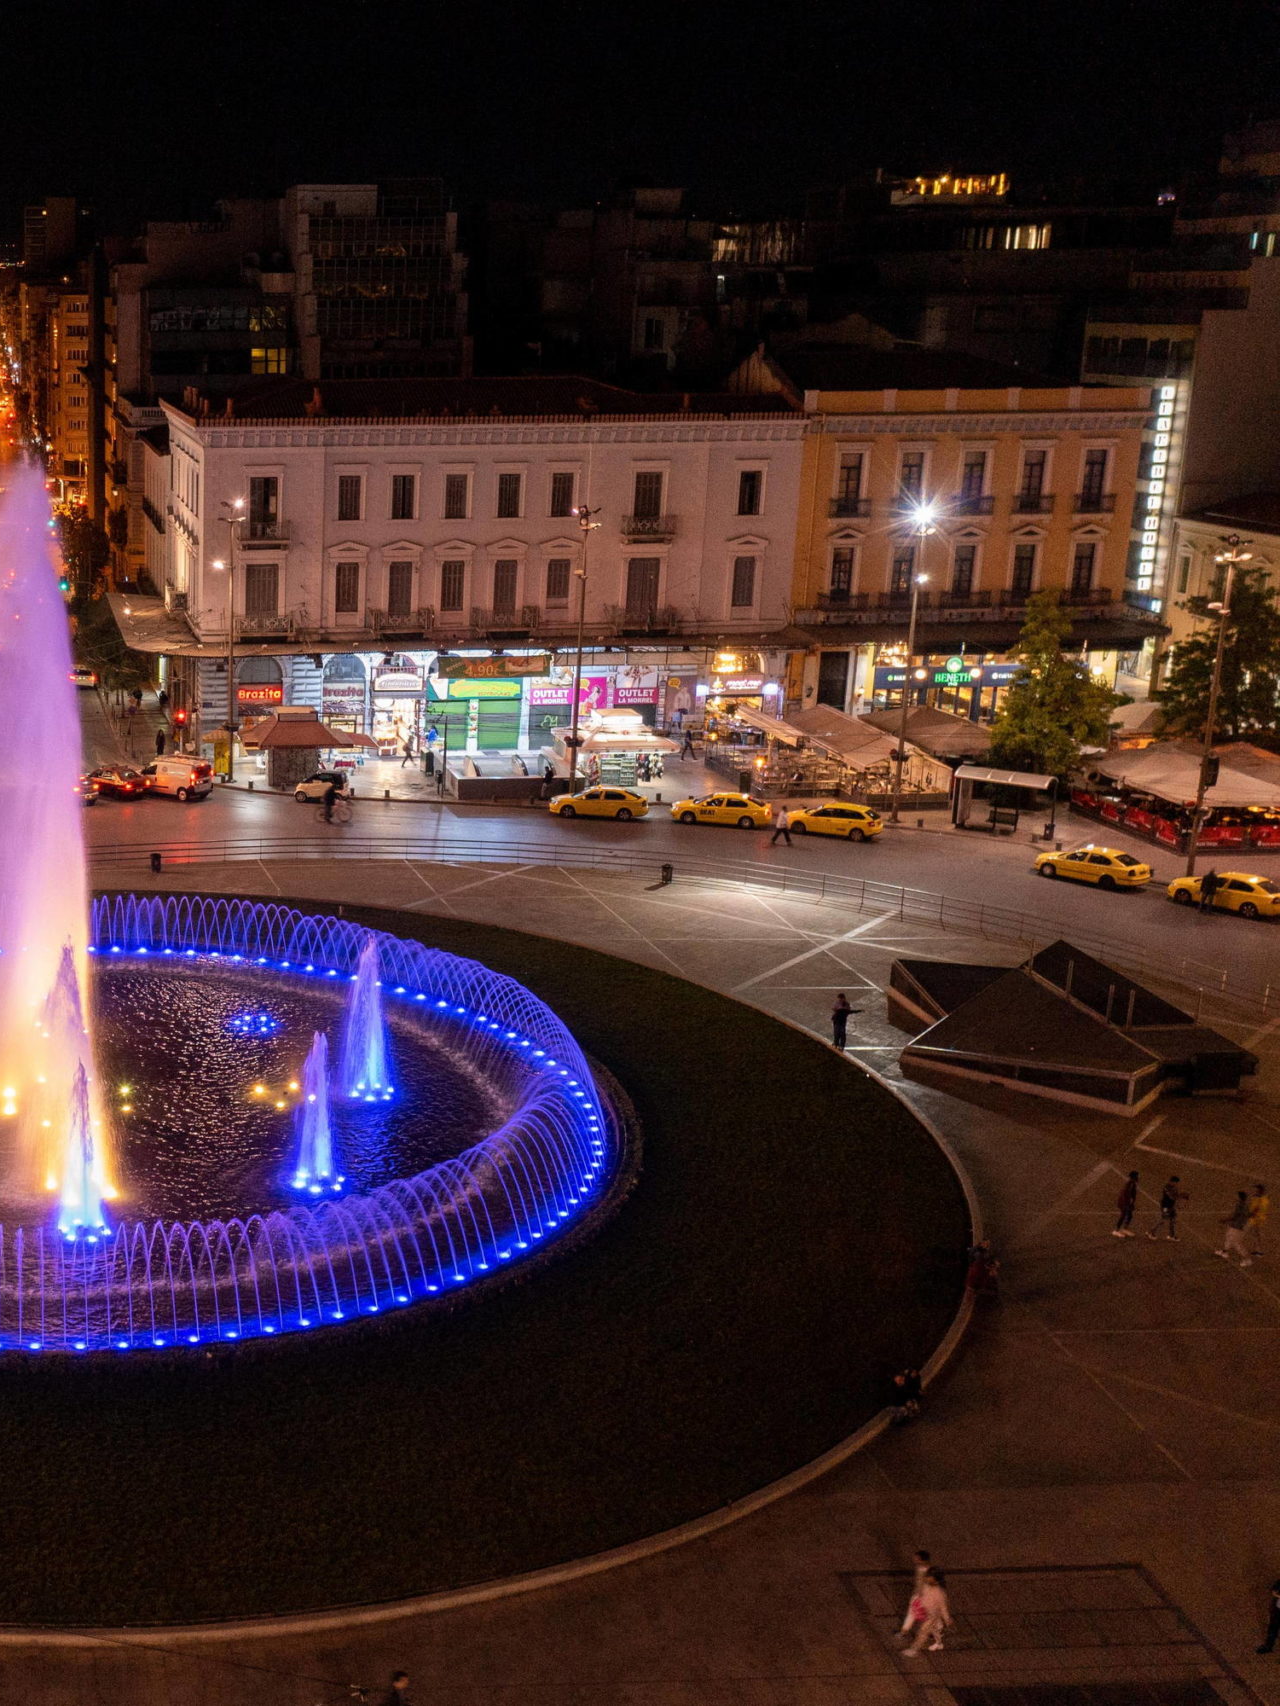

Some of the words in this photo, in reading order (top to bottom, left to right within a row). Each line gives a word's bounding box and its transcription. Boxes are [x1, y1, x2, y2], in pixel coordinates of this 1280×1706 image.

[238, 687, 282, 699] Brazita
[532, 689, 570, 698] OUTLET
[618, 689, 653, 697] OUTLET
